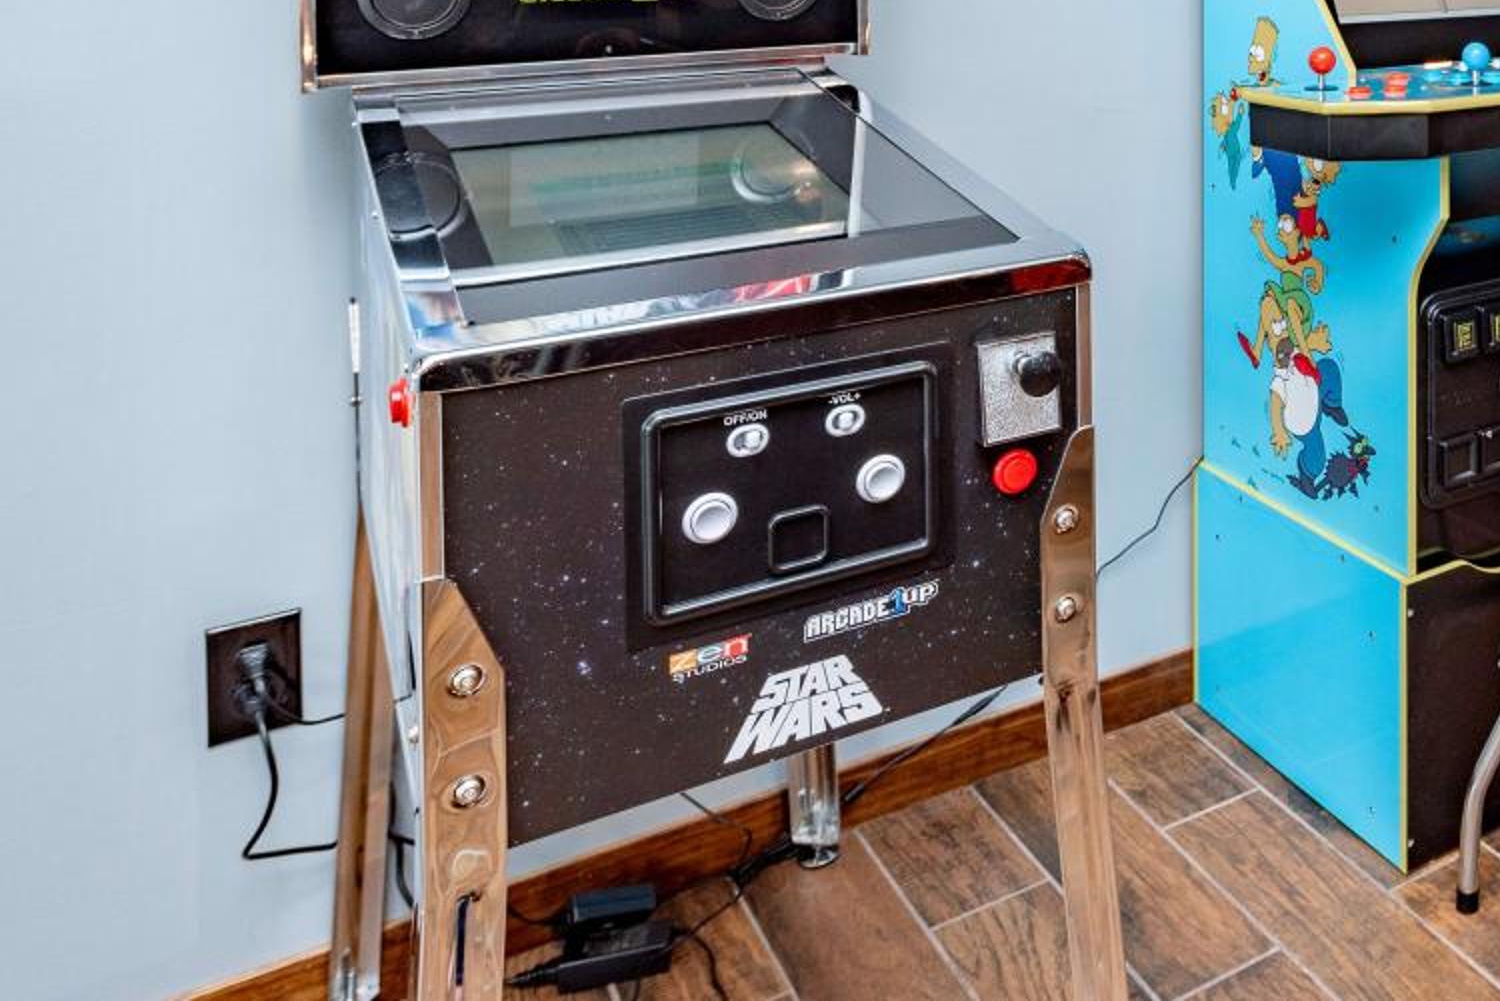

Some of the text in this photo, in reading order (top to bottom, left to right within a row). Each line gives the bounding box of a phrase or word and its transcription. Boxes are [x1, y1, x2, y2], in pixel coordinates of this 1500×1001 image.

[671, 655, 748, 683] STUDIOS
[751, 654, 863, 713] STAR
[724, 681, 884, 765] WARS
